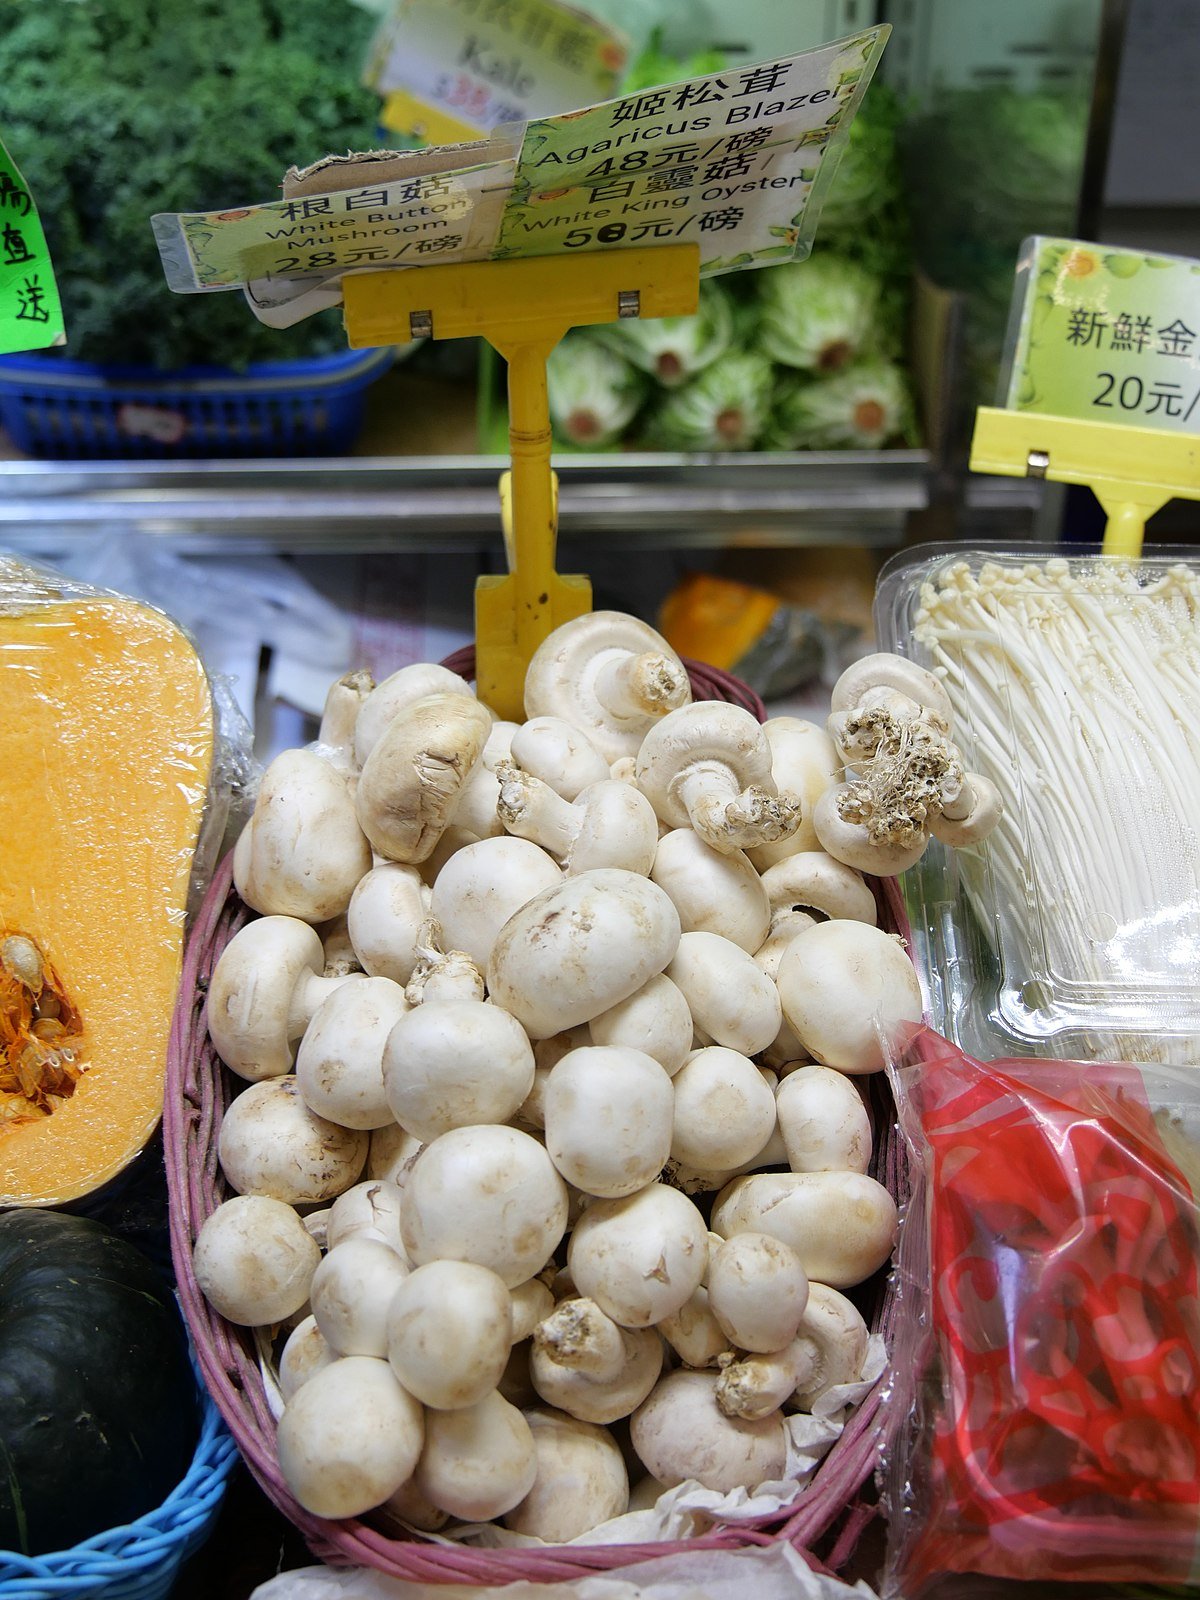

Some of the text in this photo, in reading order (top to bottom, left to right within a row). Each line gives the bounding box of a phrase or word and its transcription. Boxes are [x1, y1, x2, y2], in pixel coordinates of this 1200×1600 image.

[608, 64, 793, 128] 姬松茸
[534, 116, 712, 168] Agaricus
[585, 126, 773, 178] 48元/磅
[279, 175, 454, 222] 根白菇
[523, 175, 802, 233] White King Oyster
[588, 152, 758, 205] 白靈菇
[265, 199, 467, 240] White Button
[287, 219, 448, 250] Mushroom
[274, 233, 463, 274] 28元/磅
[1066, 307, 1200, 361] 新鮮金
